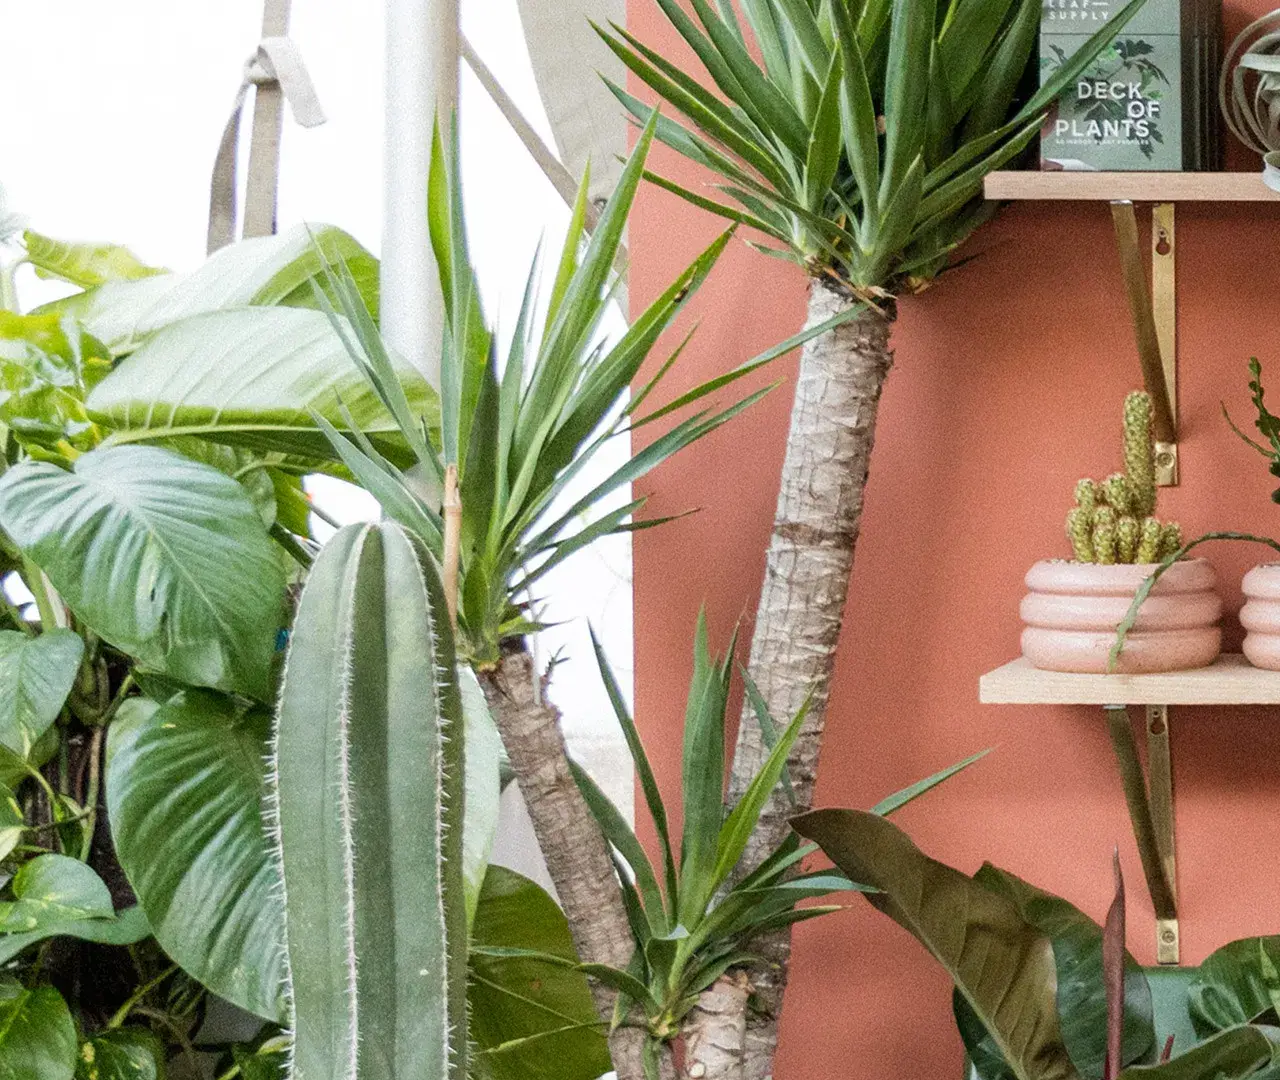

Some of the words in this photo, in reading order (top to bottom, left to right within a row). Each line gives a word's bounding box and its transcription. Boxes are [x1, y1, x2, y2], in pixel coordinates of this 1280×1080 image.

[1049, 11, 1109, 20] SUPPLY
[1078, 81, 1142, 100] DECK
[1127, 100, 1160, 119] OF
[1055, 118, 1150, 137] PLANTS
